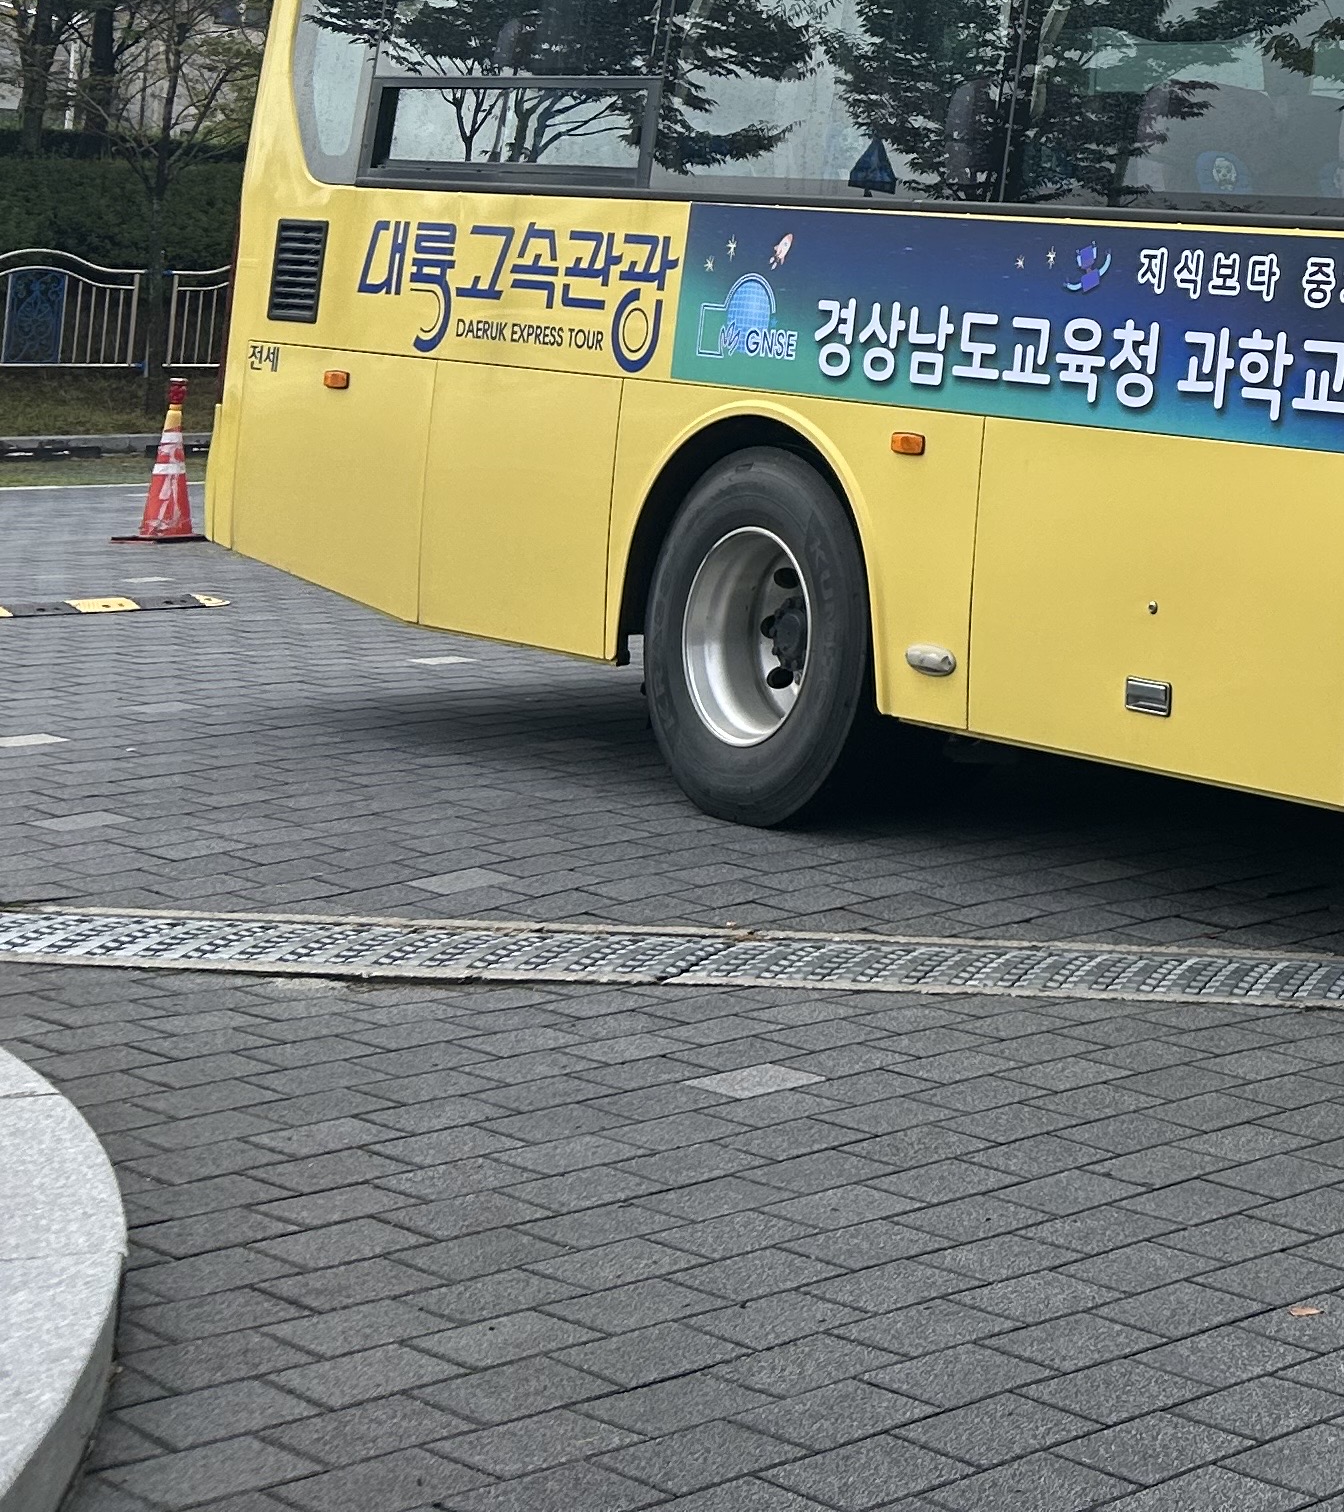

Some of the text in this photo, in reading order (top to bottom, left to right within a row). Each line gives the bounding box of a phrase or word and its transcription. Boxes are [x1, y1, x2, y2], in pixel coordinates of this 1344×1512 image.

[357, 219, 680, 373] 대륙고속관광
[1137, 247, 1280, 302] 지식보다
[456, 319, 604, 351] DAERUK EXPRESS TOUR
[745, 328, 798, 361] GNSE
[814, 297, 1161, 409] 경상남도교육청
[248, 345, 280, 374] 전세
